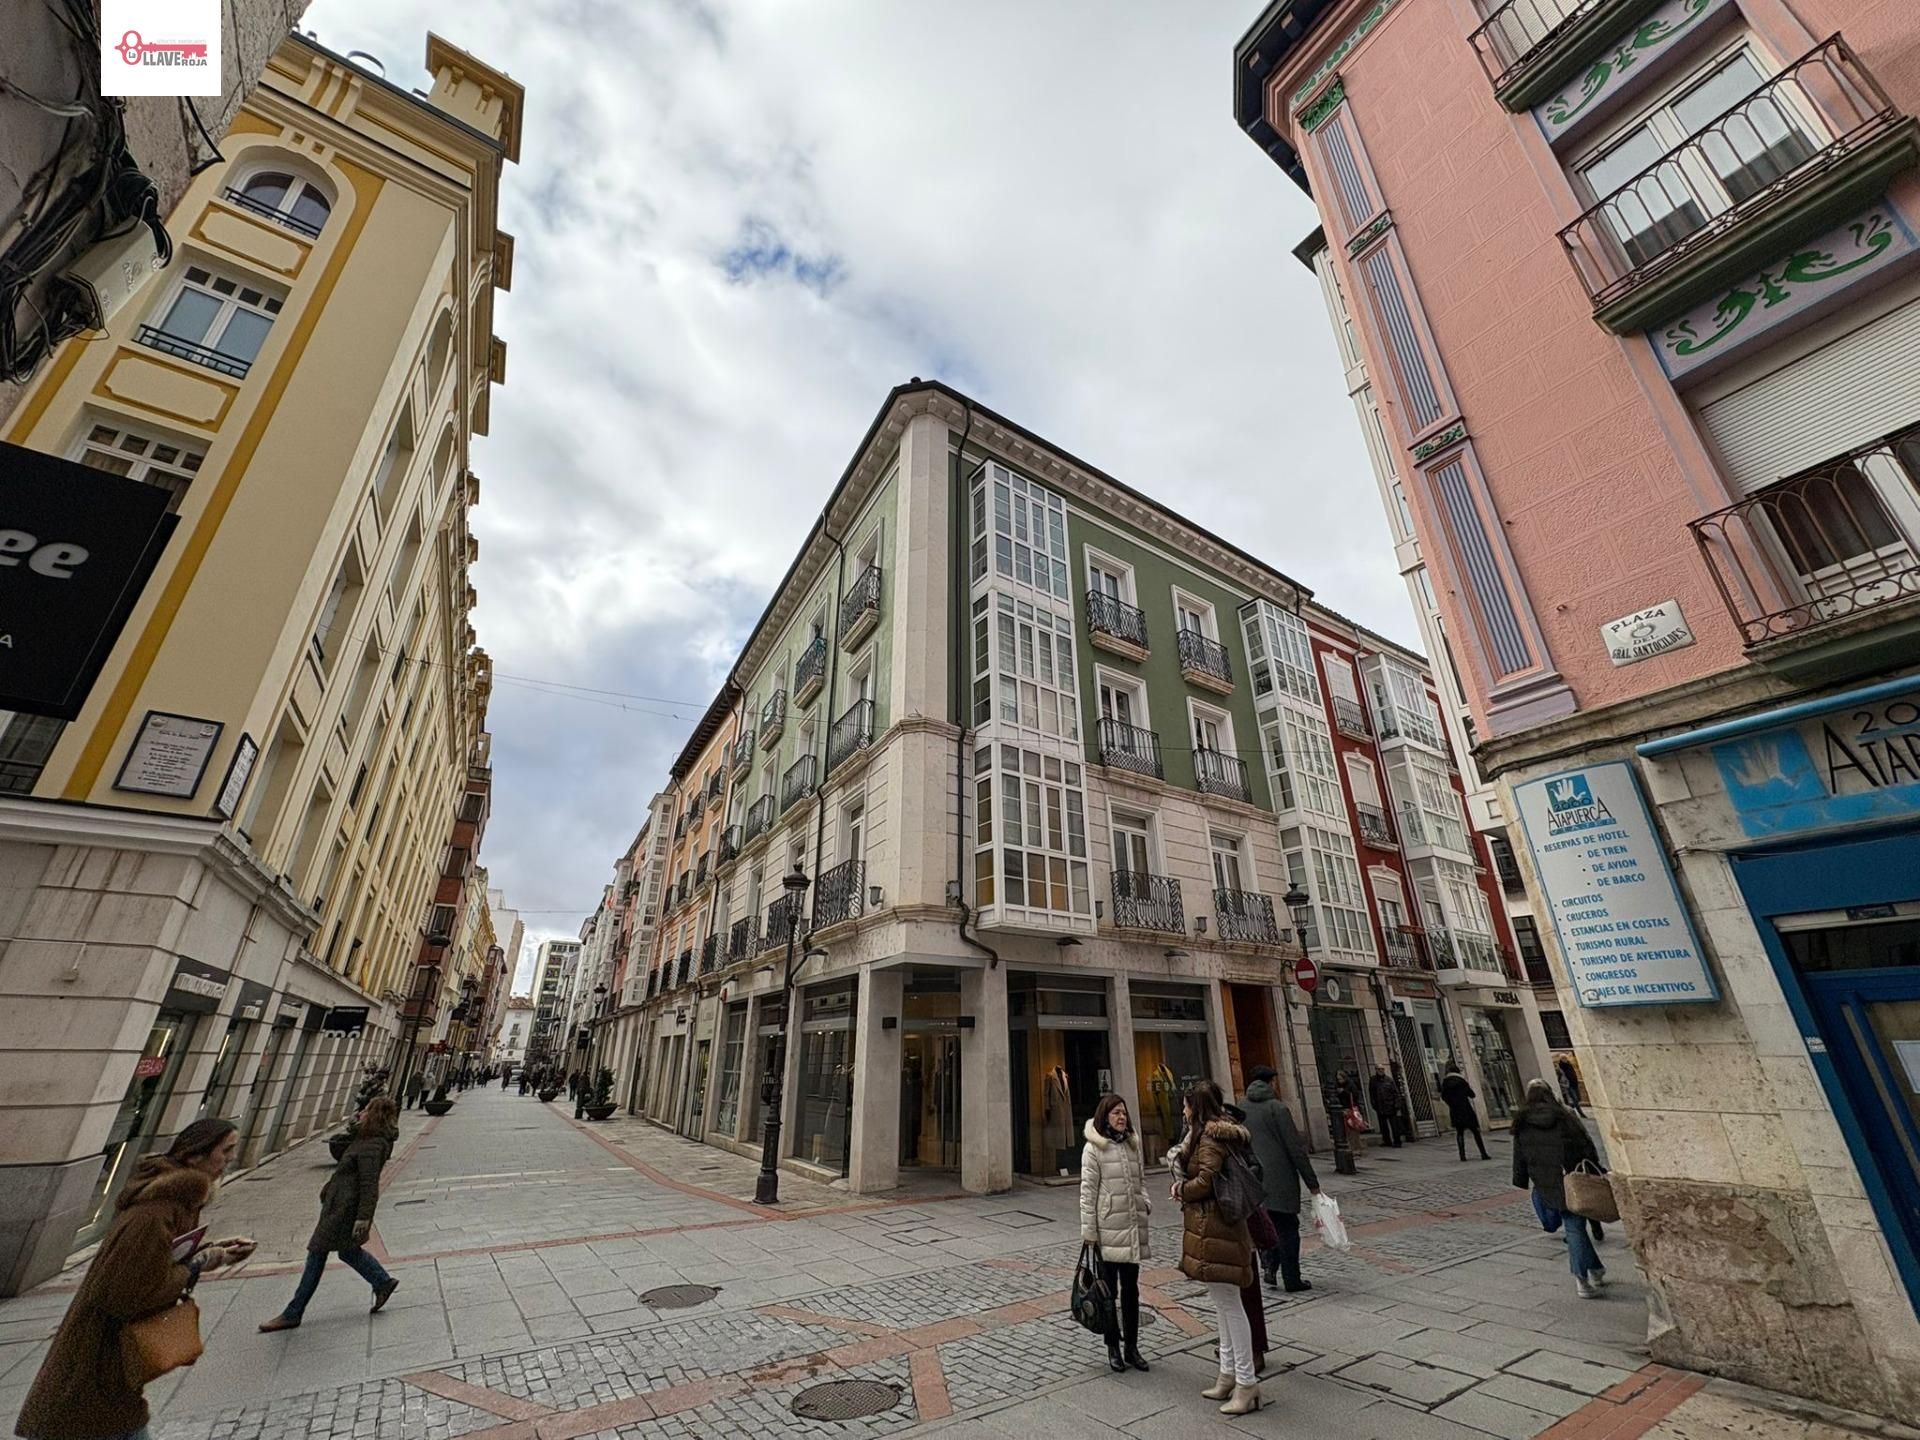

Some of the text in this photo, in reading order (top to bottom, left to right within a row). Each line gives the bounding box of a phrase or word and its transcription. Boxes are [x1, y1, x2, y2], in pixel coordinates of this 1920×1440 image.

[1611, 609, 1666, 633] PLAZA
[1633, 634, 1659, 646] DEL
[1633, 627, 1687, 657] SANTOCILDES
[1554, 797, 1592, 812] 2000
[1547, 796, 1613, 831] ATAPUERCA
[1544, 830, 1630, 853] RESERVAS DE HOTEL
[1587, 845, 1628, 858] DE TREN
[1592, 859, 1637, 873] DE AVION
[1597, 873, 1645, 887] DE BARCO
[1561, 893, 1604, 908] CIRCUITOS
[1566, 908, 1609, 922] CRUCEROS
[1571, 918, 1670, 937] ESTANCIAS EN COSTAS
[1575, 935, 1648, 951] TURISMO RURAL
[1580, 949, 1691, 966] TURISMO DE AVENTURA
[1585, 968, 1637, 982] CONGRESOS
[1618, 985, 1632, 995] DE
[1633, 982, 1696, 994] INCENTIVOS
